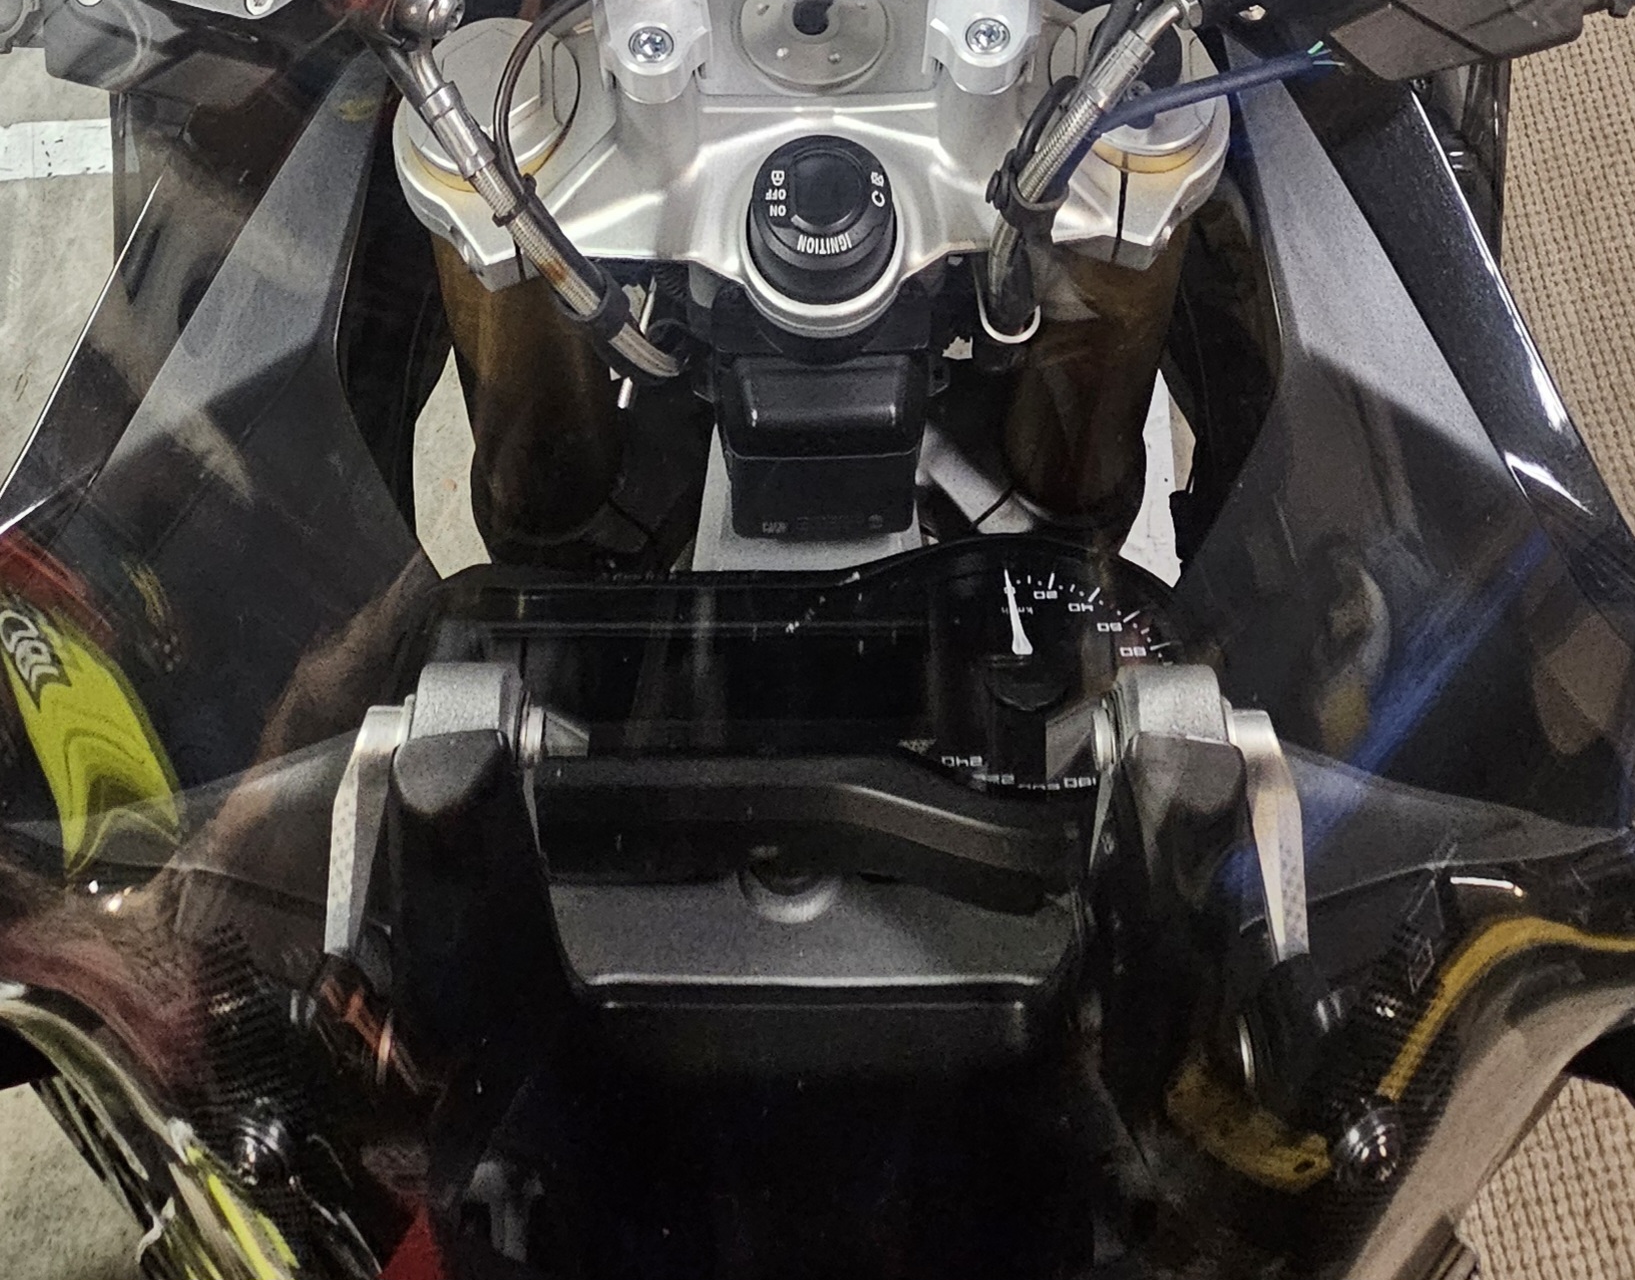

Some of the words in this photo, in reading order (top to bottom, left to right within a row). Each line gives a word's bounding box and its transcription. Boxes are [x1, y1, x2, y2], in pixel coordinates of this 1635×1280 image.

[765, 189, 786, 201] OFF
[770, 205, 786, 216] ON
[797, 232, 852, 255] IGNITION
[1033, 590, 1058, 600] 20
[1068, 602, 1094, 613] 40
[1097, 622, 1122, 633] 60
[1119, 646, 1146, 657] 80
[941, 755, 983, 767] 240
